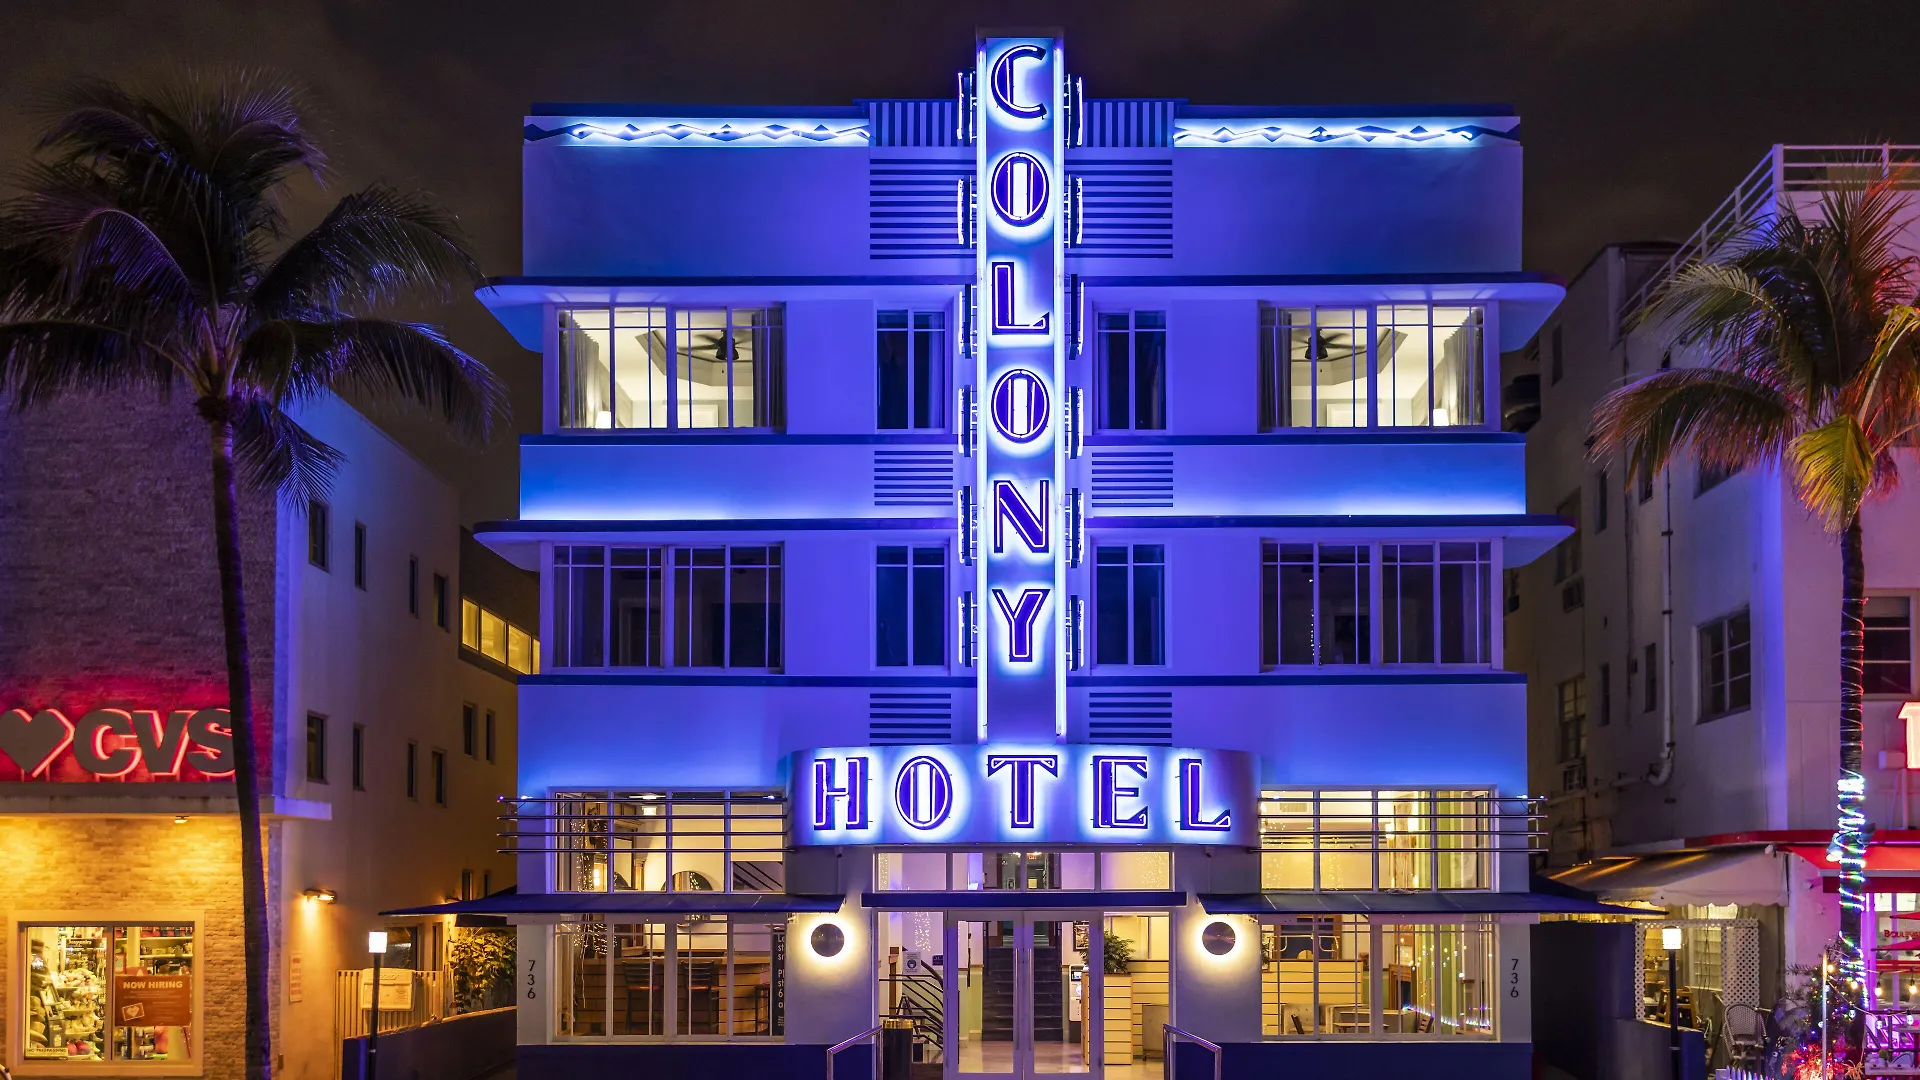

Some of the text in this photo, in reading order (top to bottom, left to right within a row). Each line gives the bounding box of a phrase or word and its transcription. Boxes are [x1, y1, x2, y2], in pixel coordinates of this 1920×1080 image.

[990, 45, 1051, 663] COLONY
[73, 707, 236, 777] CVS
[813, 754, 1231, 831] HOTEL
[123, 980, 183, 989] NOW HIRING
[527, 959, 536, 999] 736
[1510, 958, 1519, 998] 736
